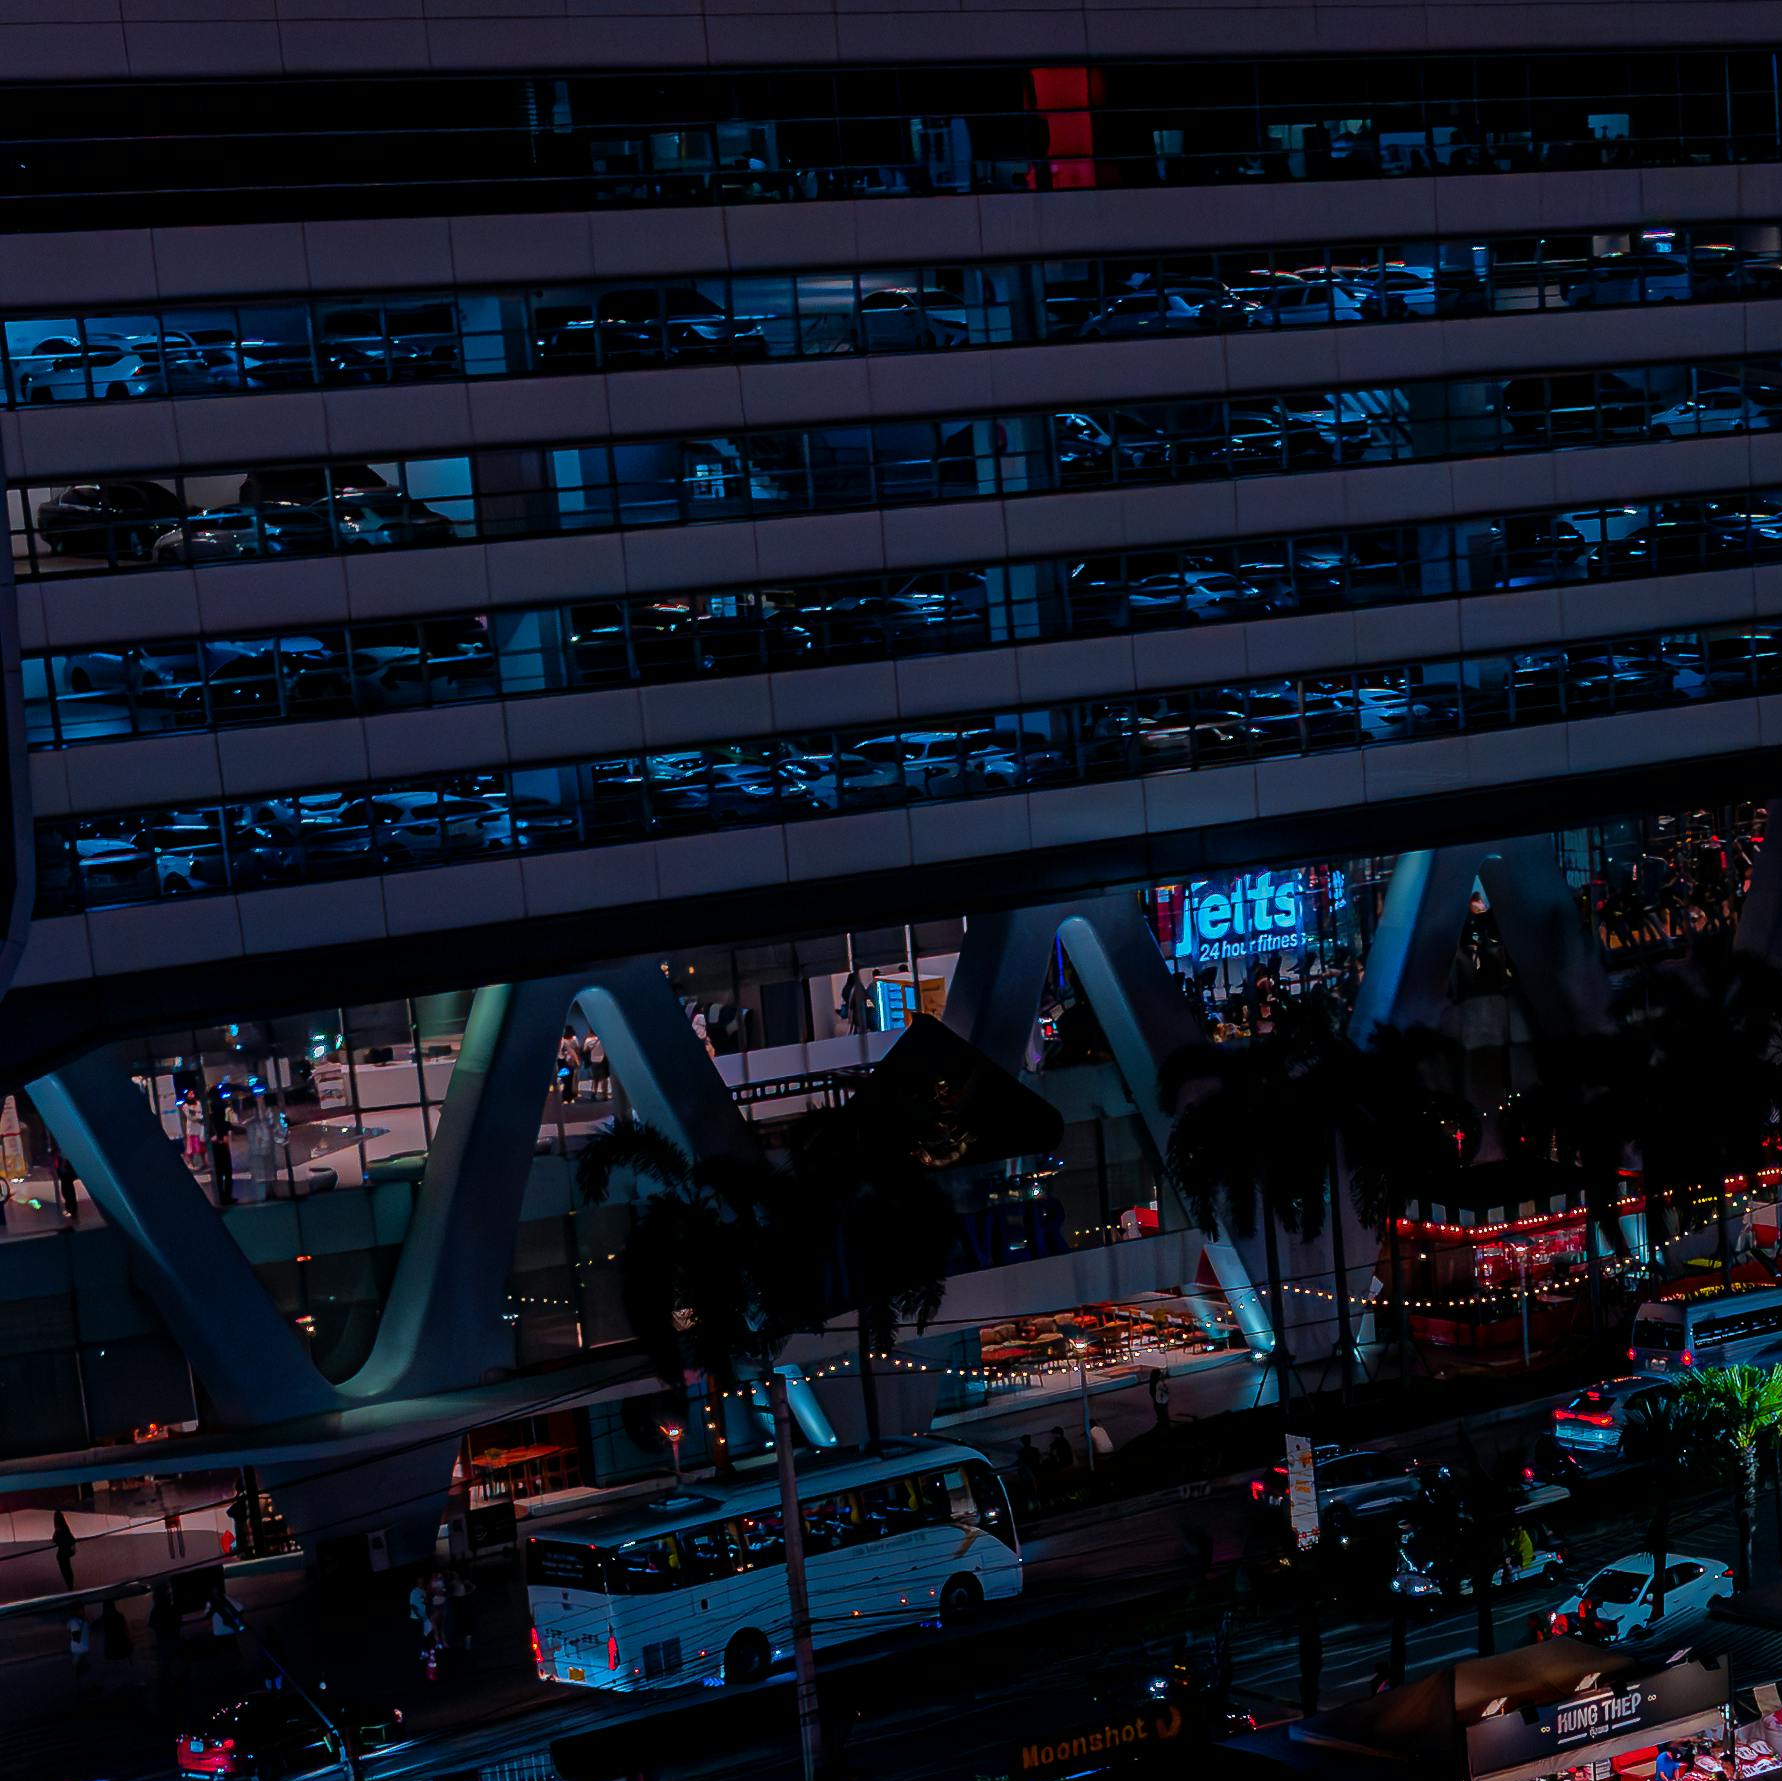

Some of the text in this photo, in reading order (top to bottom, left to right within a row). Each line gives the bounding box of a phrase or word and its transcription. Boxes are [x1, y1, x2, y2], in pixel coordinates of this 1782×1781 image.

[1200, 943, 1218, 961] 24
[1557, 1704, 1598, 1734] KUNG
[1601, 1692, 1641, 1721] THEP
[1021, 1714, 1150, 1770] Moonshot
